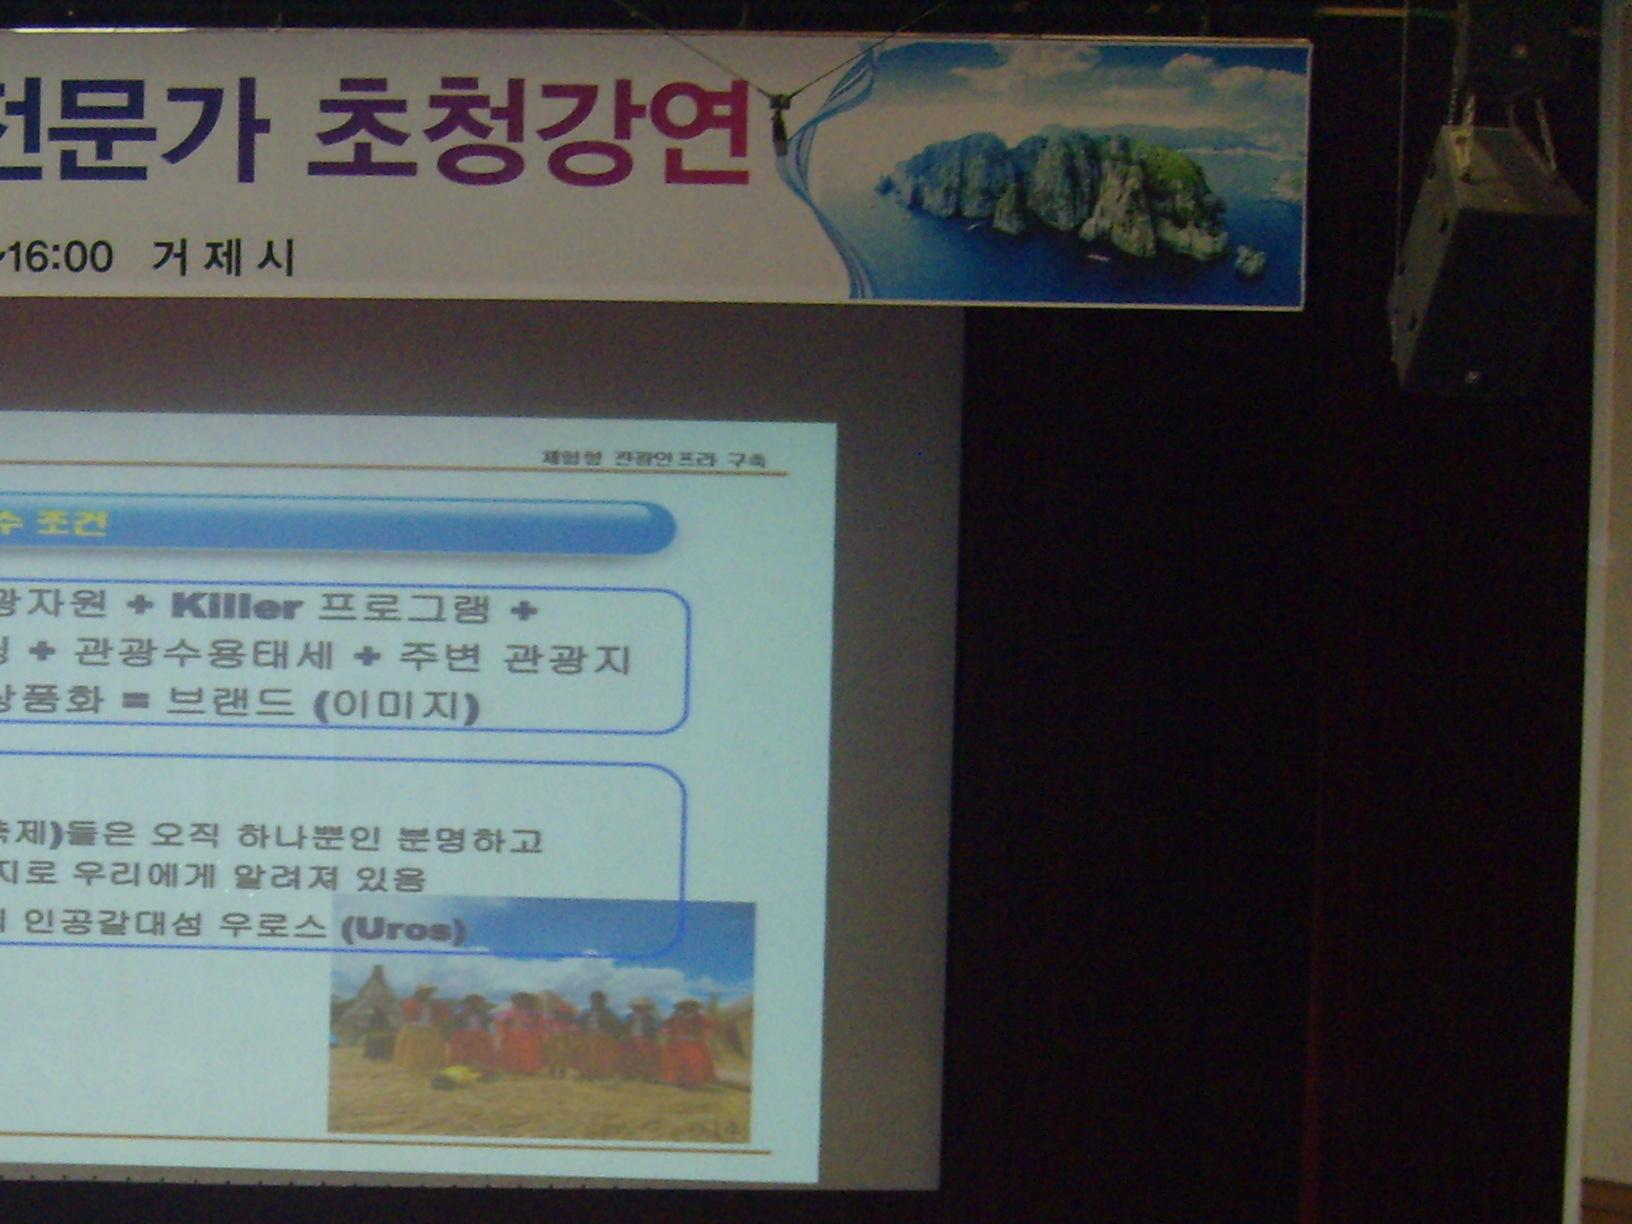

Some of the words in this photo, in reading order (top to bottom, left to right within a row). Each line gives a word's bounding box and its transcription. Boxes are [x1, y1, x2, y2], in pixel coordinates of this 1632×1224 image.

[306, 76, 751, 187] 초청강연
[37, 509, 108, 538] 조건
[171, 590, 305, 621] Killer
[317, 593, 492, 625] 프로그램
[74, 636, 334, 672] 관광수용태세
[399, 641, 482, 675] 주변
[502, 643, 632, 677] 관광지
[167, 687, 296, 721] 브랜드
[313, 689, 481, 727] (이미지)
[151, 821, 220, 850] 오직
[238, 822, 381, 853] 하나뿐인
[397, 824, 544, 855] 분명하고
[72, 860, 216, 891] 우리에게
[233, 863, 340, 893] 알려져
[355, 865, 427, 894] 있음
[24, 907, 204, 939] 인공갈대섬
[219, 912, 328, 941] 우로스
[340, 914, 468, 948] (Uros)
